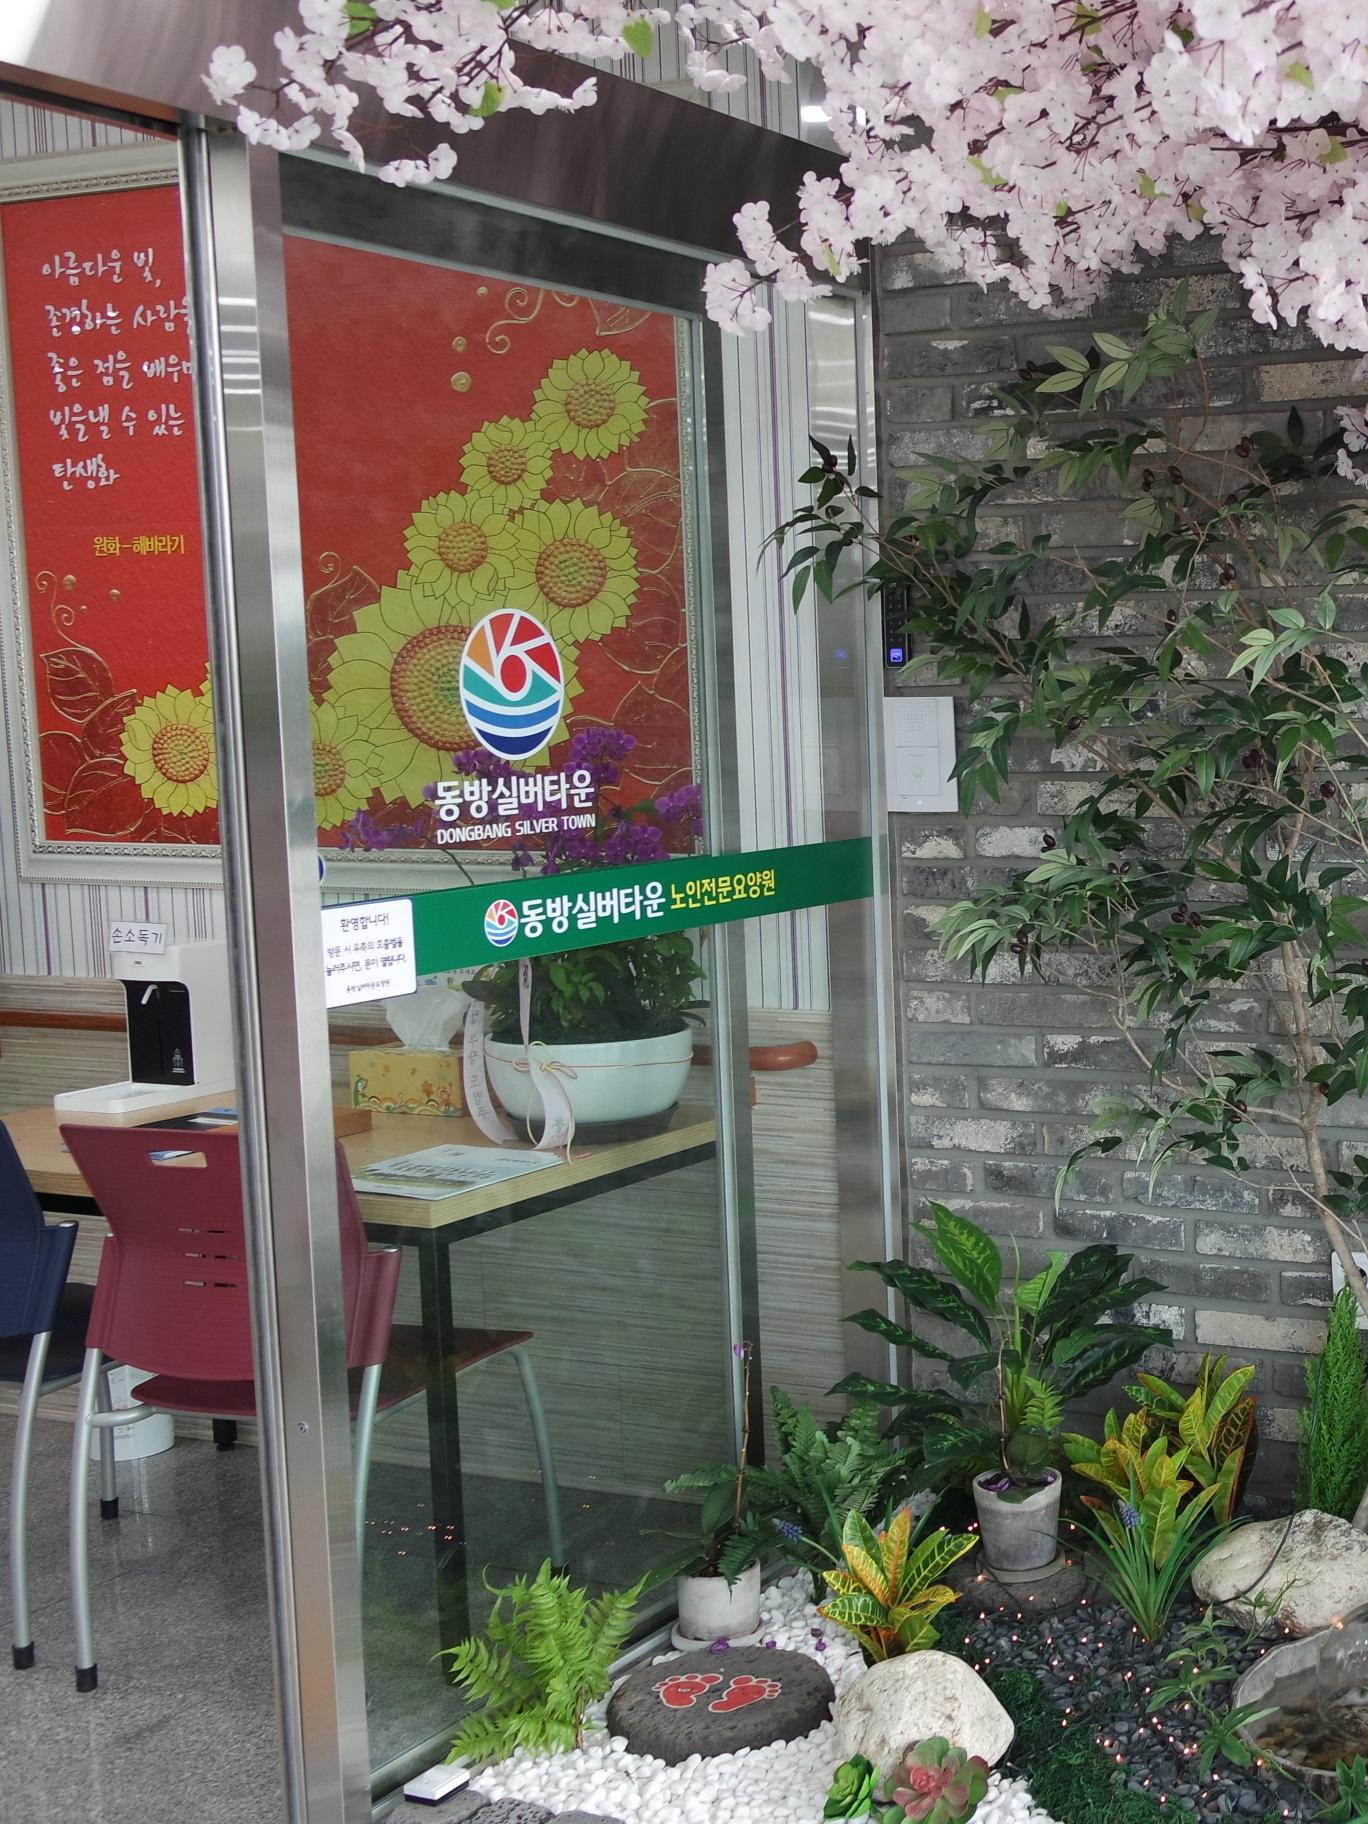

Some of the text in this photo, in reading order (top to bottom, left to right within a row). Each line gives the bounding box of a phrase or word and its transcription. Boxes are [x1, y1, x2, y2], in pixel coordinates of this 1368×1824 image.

[42, 248, 161, 288] 아름다운 빛,
[46, 300, 122, 336] 존경하는
[48, 352, 84, 392] 좋은
[93, 351, 133, 389] 점을
[120, 406, 137, 436] 수
[147, 404, 186, 436] 있는
[52, 454, 120, 490] 탄생화
[434, 769, 596, 822] 동방실버타운
[436, 813, 597, 845] DONGBANG SILVER TOWN
[520, 869, 776, 939] 동방실버타운 노인전문요양원
[111, 927, 163, 947] 손소독기
[341, 913, 389, 932] 환영합니다!
